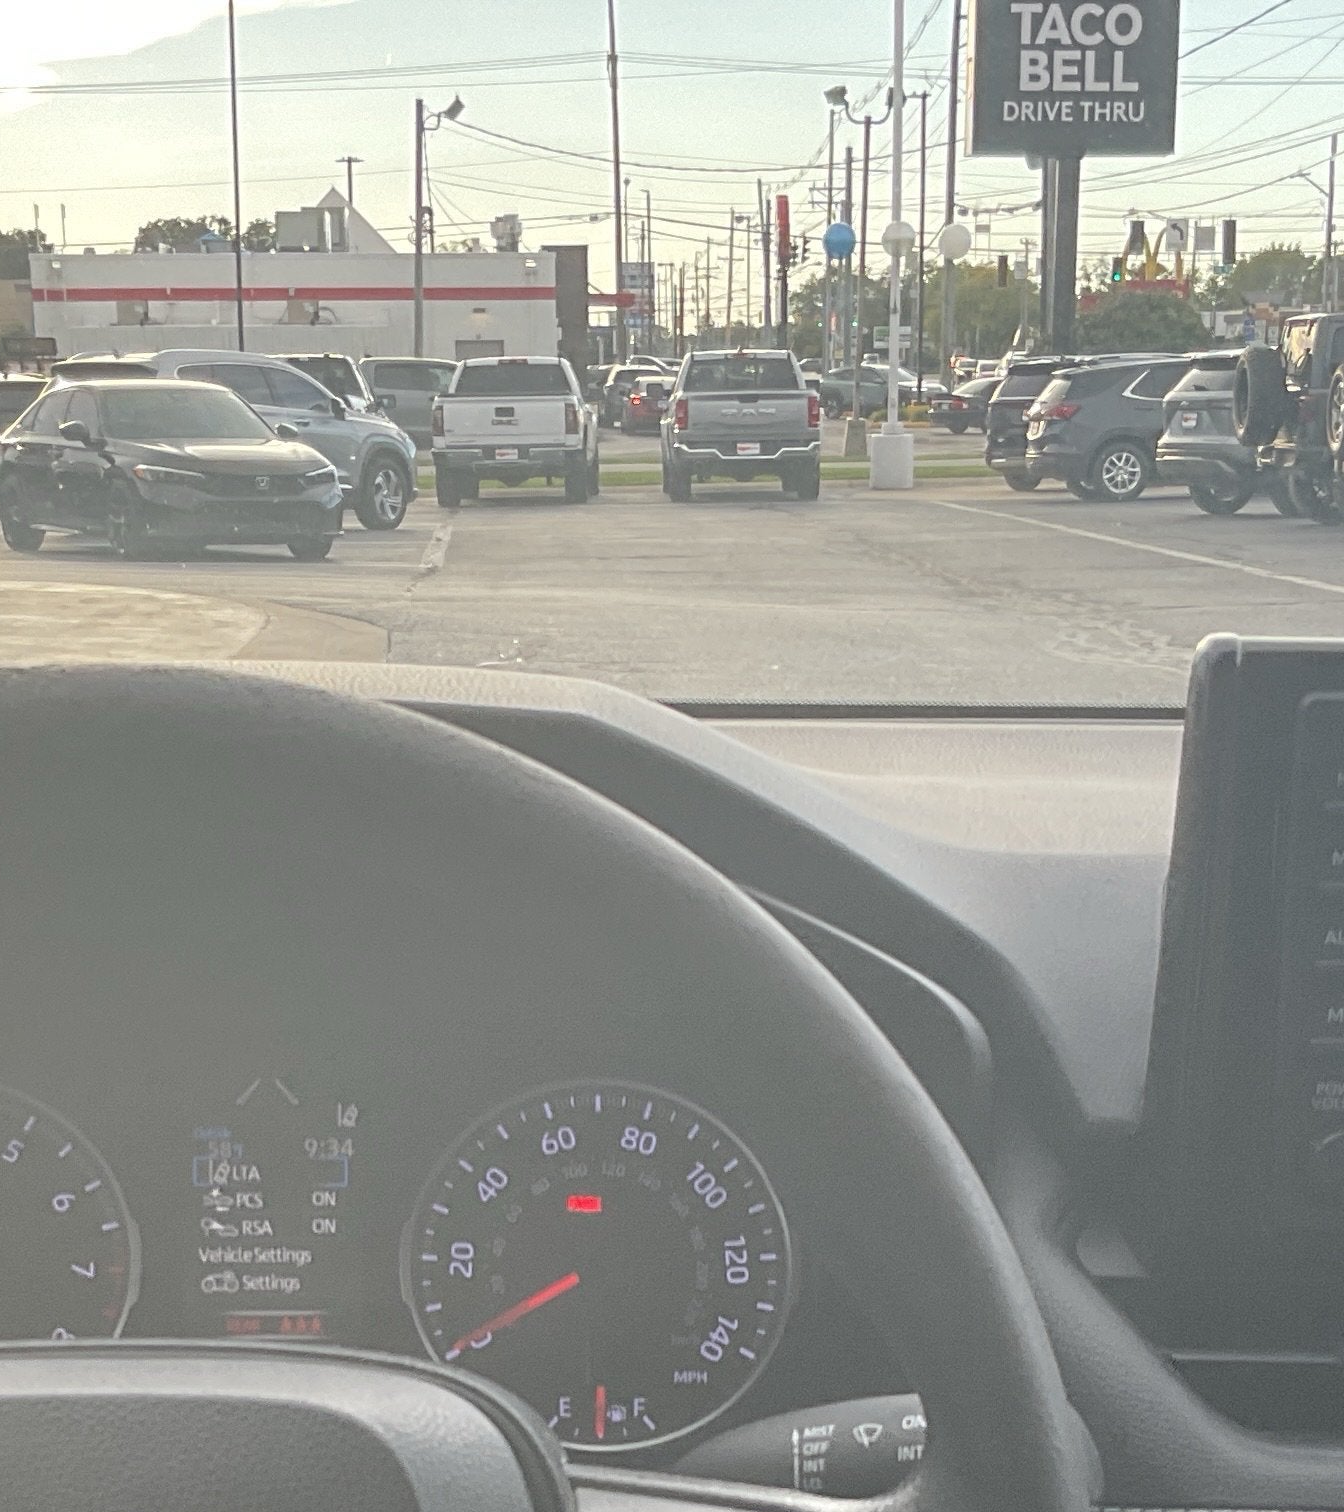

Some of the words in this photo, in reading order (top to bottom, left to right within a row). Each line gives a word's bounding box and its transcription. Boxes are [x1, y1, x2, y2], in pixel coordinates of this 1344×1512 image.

[1011, 3, 1143, 46] TACO
[1019, 51, 1139, 92] BELL
[1003, 101, 1073, 122] DRIVE
[1080, 101, 1145, 122] THRU
[2, 1139, 24, 1163] 5
[542, 1126, 576, 1155] 60
[620, 1126, 656, 1155] 80
[232, 1165, 261, 1182] LTA
[477, 1168, 508, 1203] 40
[686, 1161, 727, 1208] 100
[52, 1192, 75, 1212] 6
[236, 1192, 264, 1209] PCS
[312, 1191, 337, 1207] ON
[242, 1219, 274, 1236] RSA
[312, 1218, 337, 1235] ON
[198, 1246, 253, 1263] Vehicle
[254, 1246, 312, 1267] Settings
[449, 1242, 474, 1278] 20
[724, 1236, 749, 1285] 120
[71, 1261, 95, 1279] 7
[242, 1274, 301, 1294] Settings
[700, 1315, 739, 1362] 140
[673, 1370, 708, 1385] MPH
[558, 1397, 572, 1419] E
[633, 1398, 646, 1417] F
[897, 1444, 925, 1462] INT
[803, 1458, 826, 1473] INT
